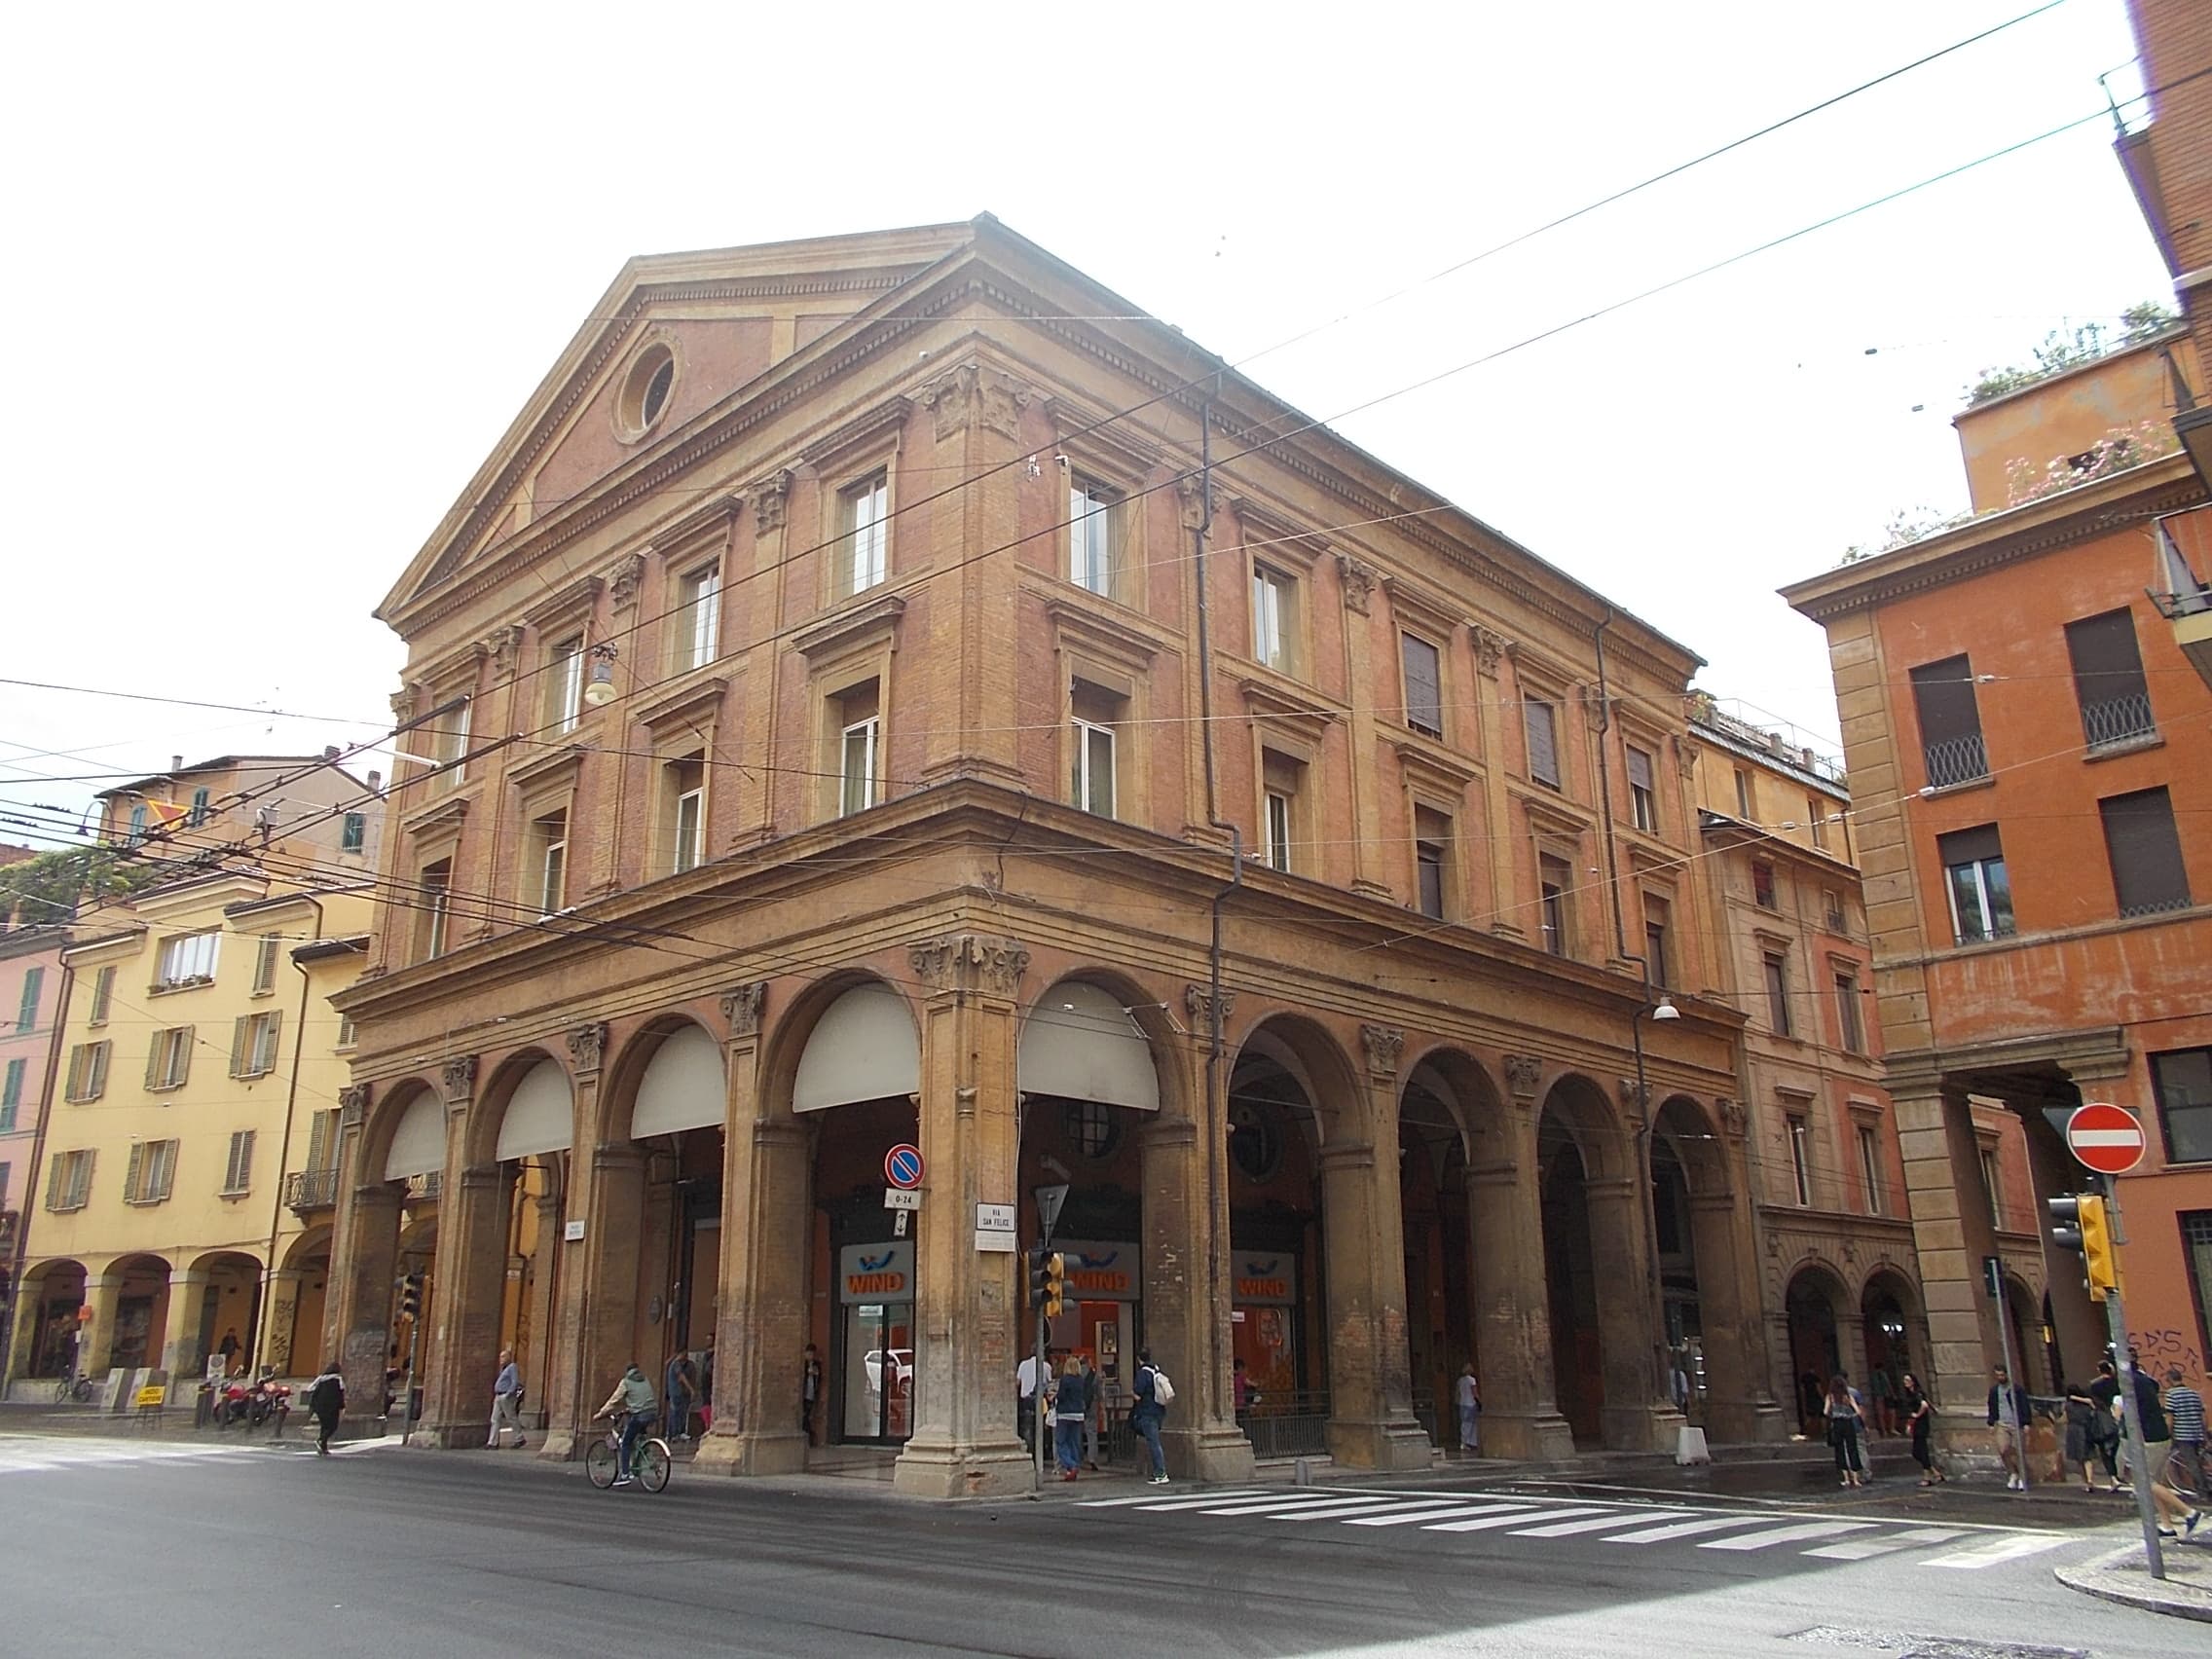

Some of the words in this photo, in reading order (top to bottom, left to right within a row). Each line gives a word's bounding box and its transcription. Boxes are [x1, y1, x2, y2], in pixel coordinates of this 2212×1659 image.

[895, 1195, 912, 1203] 0-24
[982, 1217, 992, 1226] SAN
[993, 1218, 1010, 1227] FELICE
[847, 1272, 904, 1294] WIND
[1068, 1270, 1130, 1292] WIND
[1237, 1277, 1288, 1298] WIND
